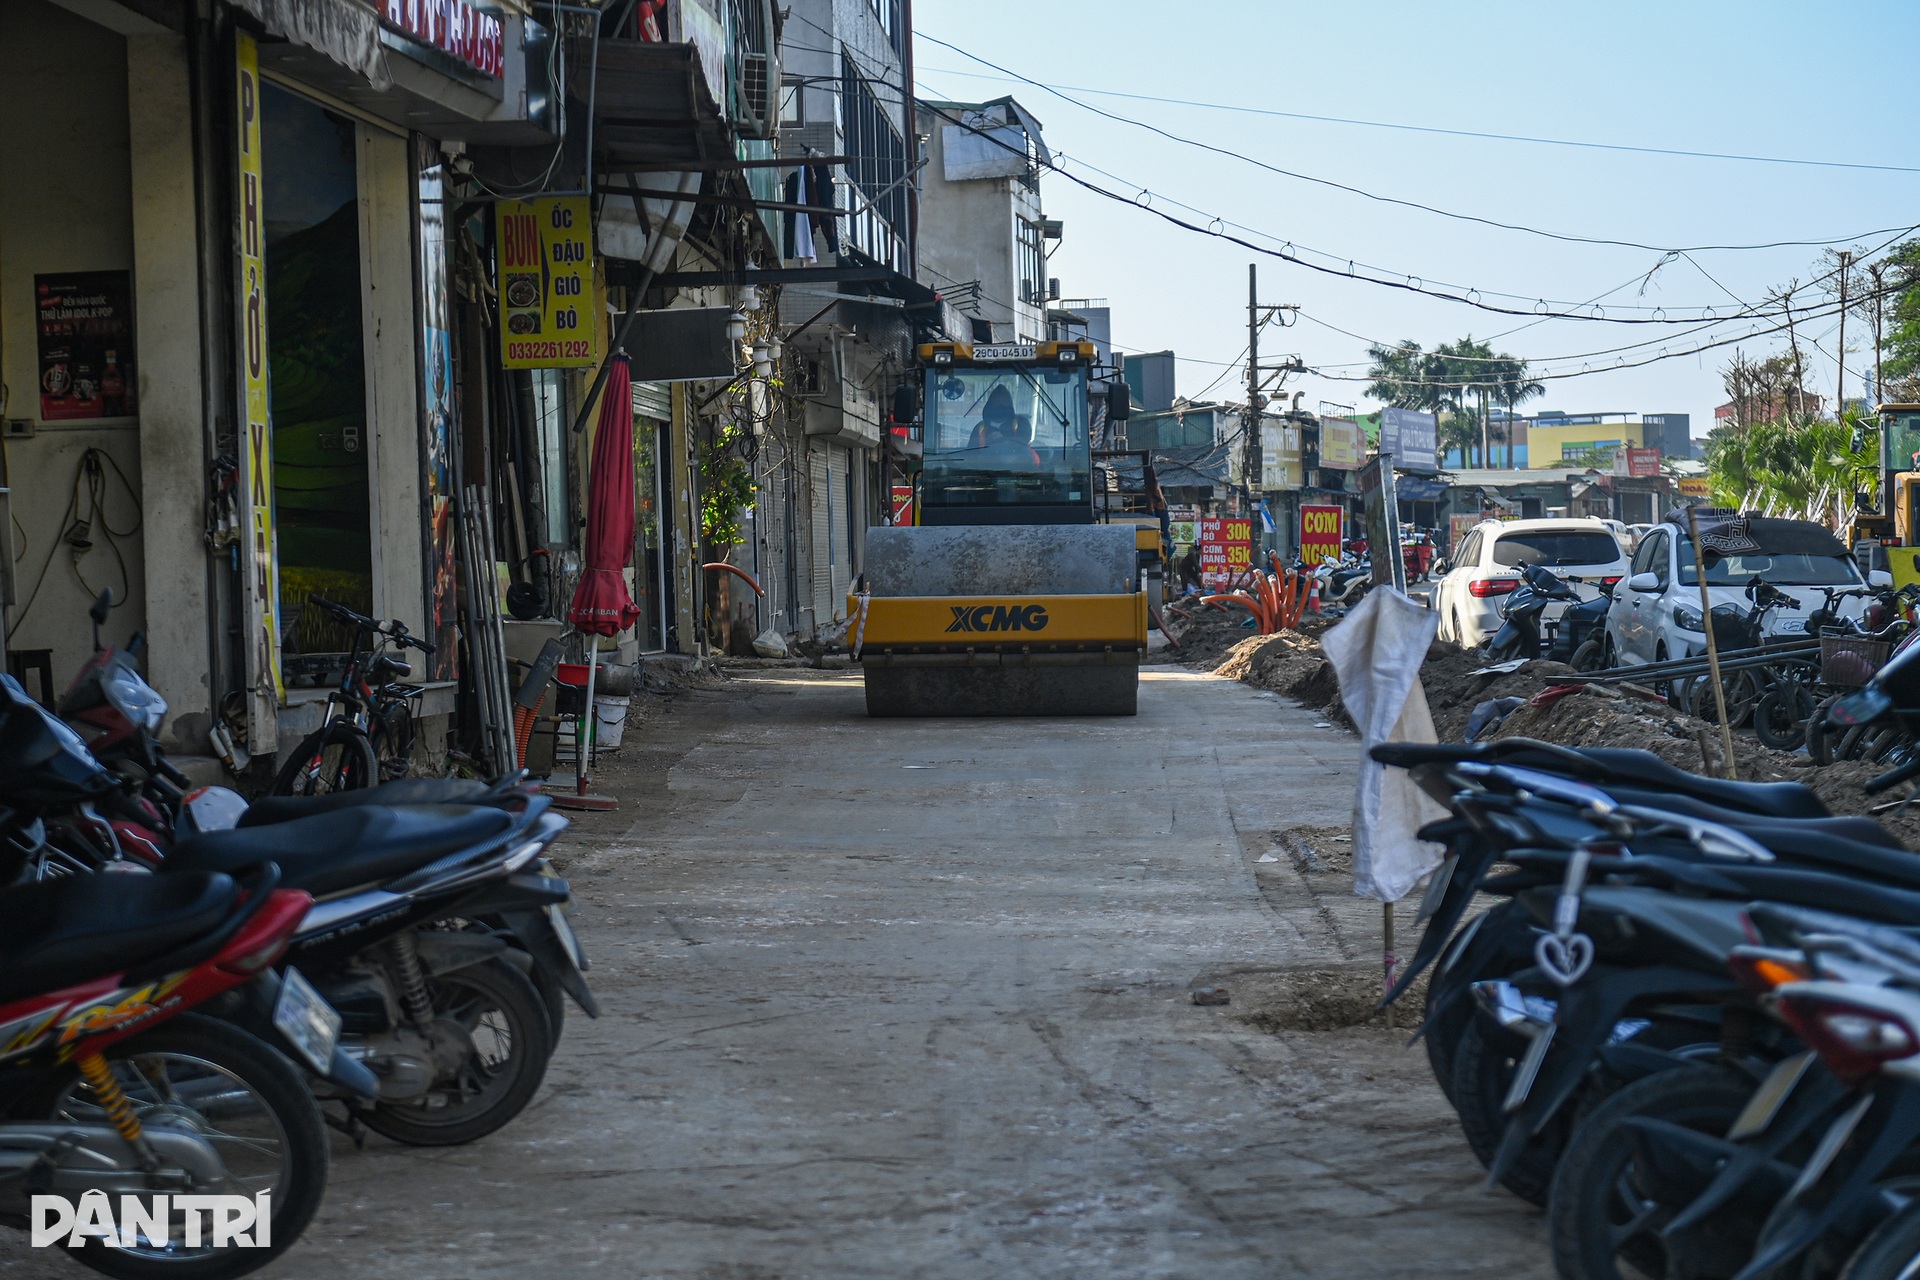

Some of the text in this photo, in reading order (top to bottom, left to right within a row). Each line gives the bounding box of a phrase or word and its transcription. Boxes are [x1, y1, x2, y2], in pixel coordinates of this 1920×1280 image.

[447, 0, 504, 79] HOUSE
[240, 69, 261, 380] PHỞ
[551, 202, 574, 229] ỐC
[503, 203, 539, 267] BÚN
[552, 238, 586, 267] ĐẬU
[554, 271, 581, 296] GIÒ
[555, 304, 578, 330] BÒ
[508, 340, 590, 360] 0332261292
[1203, 520, 1221, 531] PHỞ
[1227, 522, 1251, 540] 30k
[1304, 510, 1338, 534] CƠM
[1203, 544, 1222, 554] CƠM
[1203, 554, 1226, 563] RANG
[1227, 546, 1251, 563] 35k
[1301, 543, 1339, 565] NGON
[945, 604, 1049, 632] XCMG
